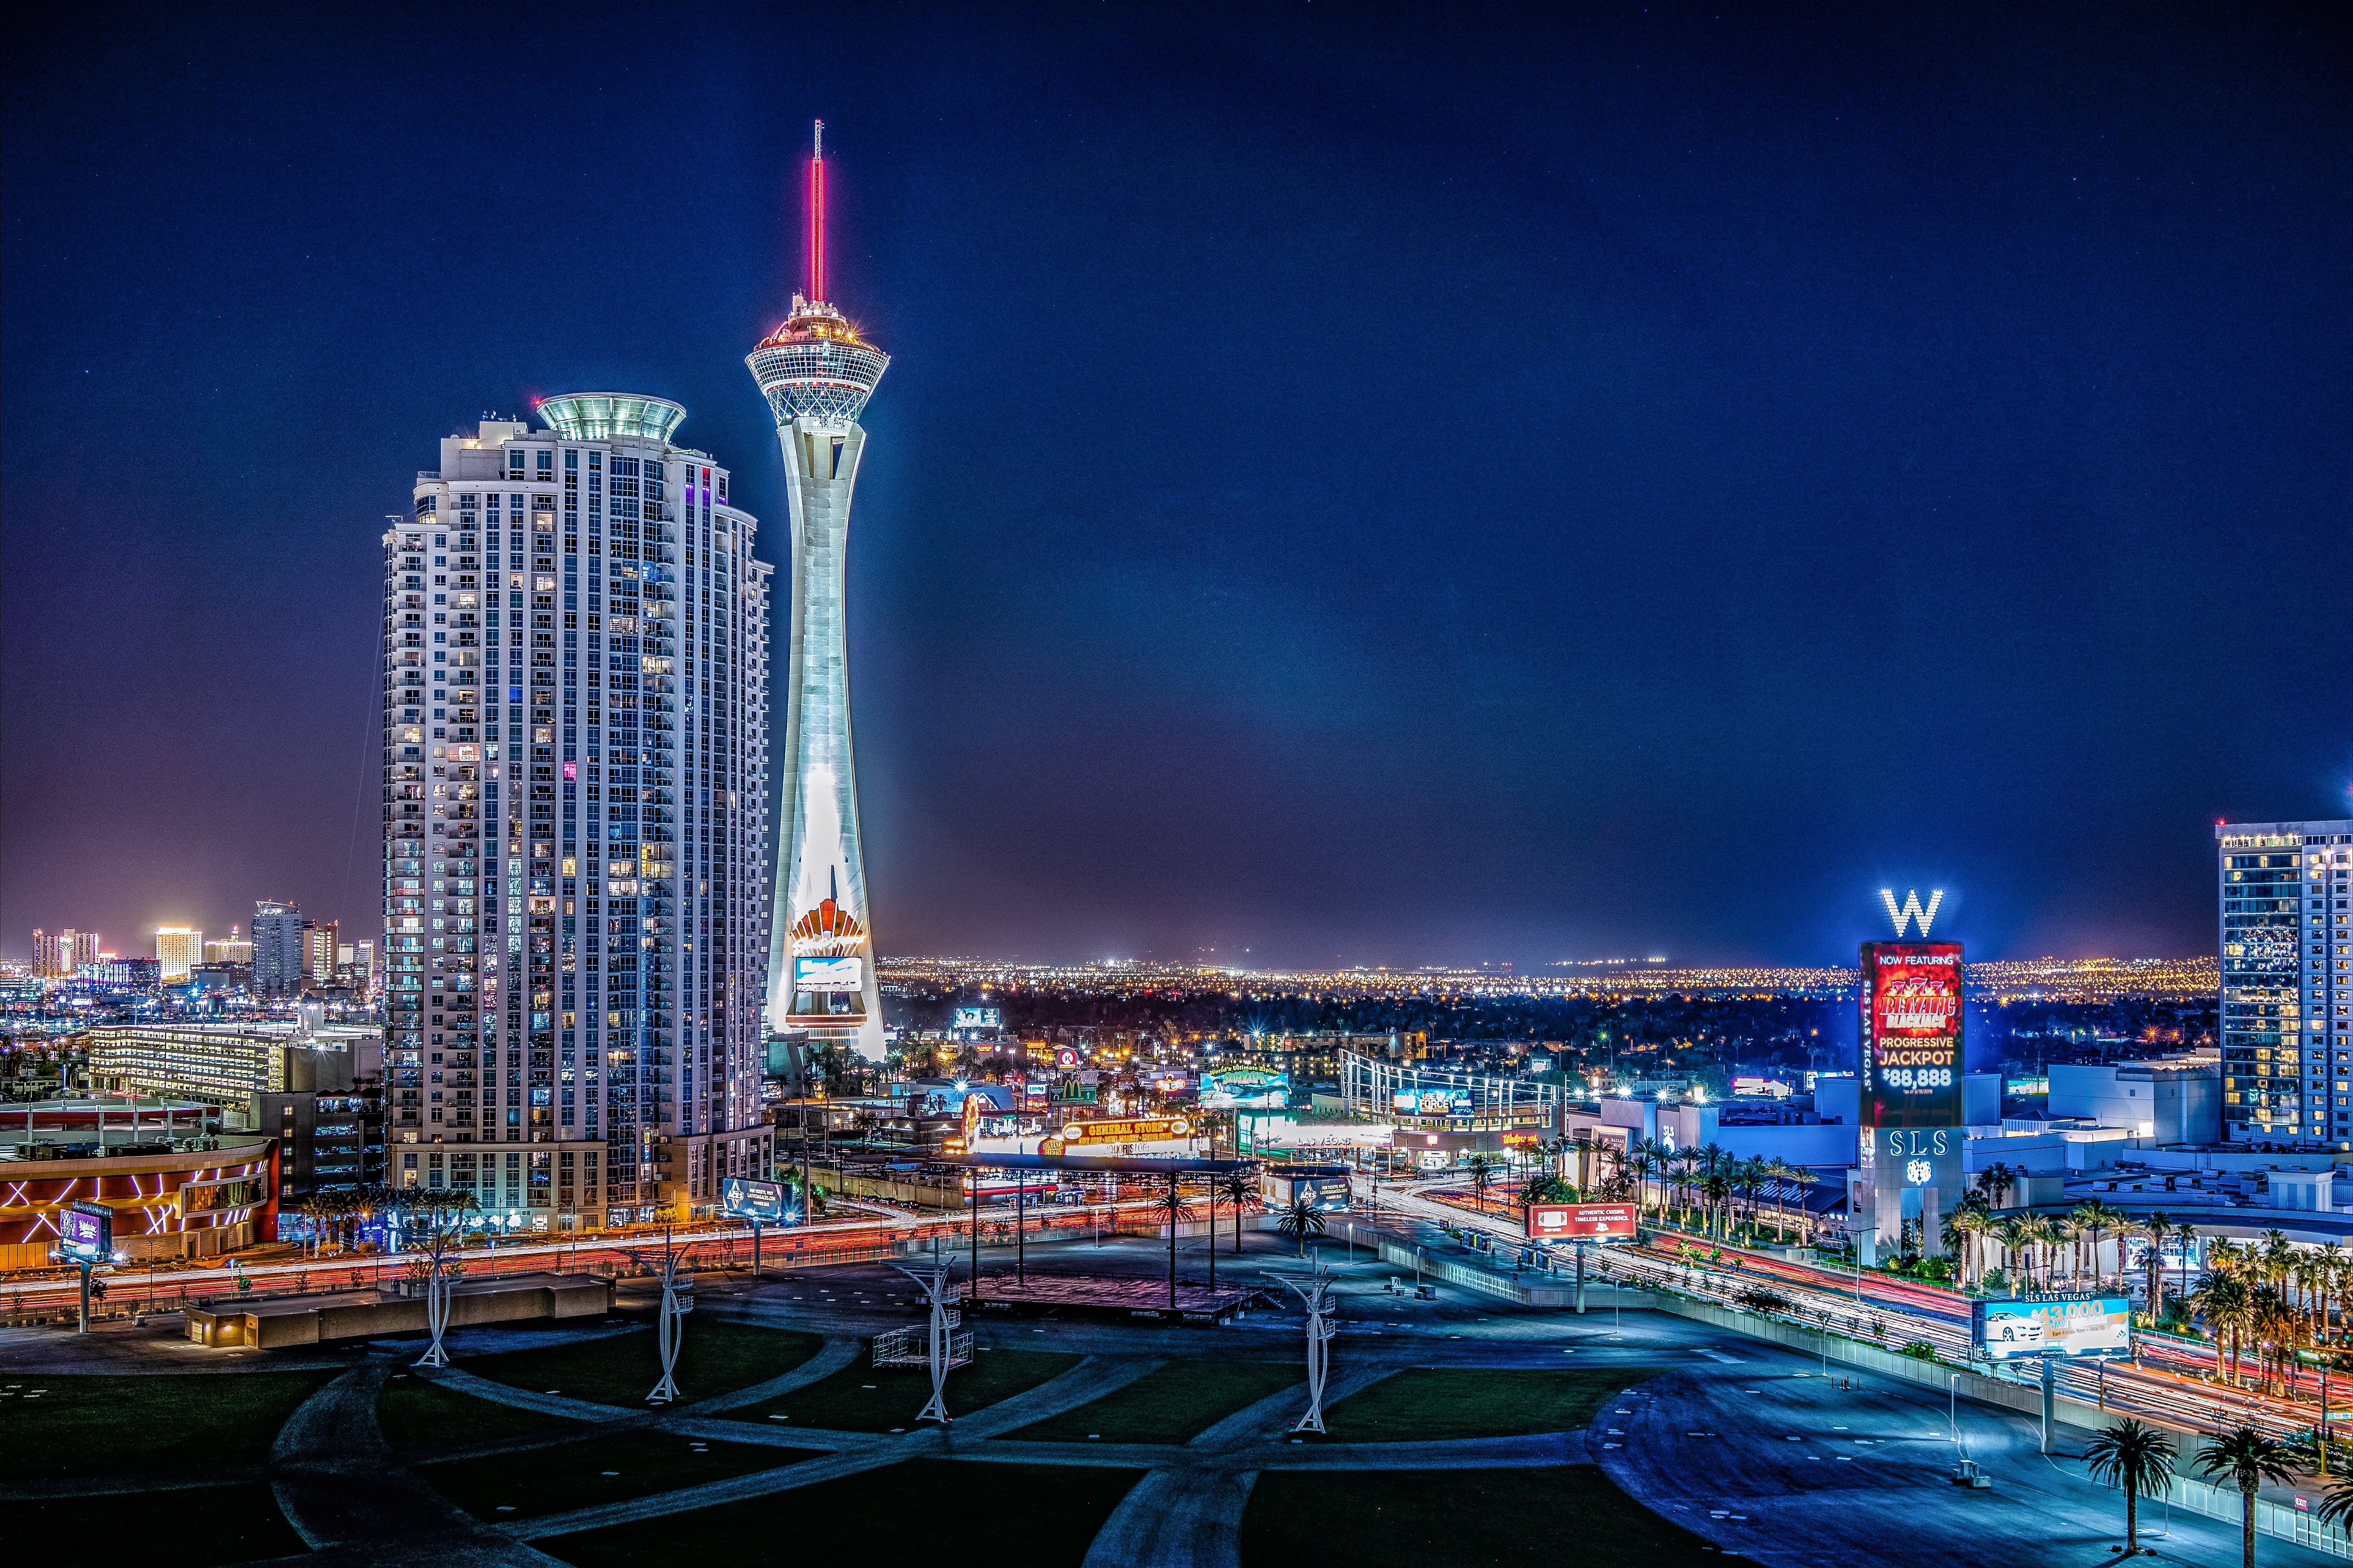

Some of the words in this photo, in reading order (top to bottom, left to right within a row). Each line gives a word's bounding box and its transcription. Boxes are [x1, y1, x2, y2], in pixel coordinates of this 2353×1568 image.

[1881, 889, 1944, 938] W
[1879, 956, 1903, 965] NOW
[1905, 956, 1953, 965] FEATURING
[1879, 996, 1956, 1016] BLAZING
[1886, 1015, 1947, 1028] BLACKJACK
[1880, 1038, 1954, 1047] PROGRESSIVE
[1879, 1051, 1954, 1066] JACKPOT
[1210, 1066, 1232, 1075] World's
[1259, 1066, 1280, 1075] Zipline
[1223, 1070, 1267, 1085] SLOTZILLA
[1882, 1068, 1951, 1089] $88,888
[1419, 1099, 1449, 1108] FORCE
[1089, 1124, 1132, 1136] GENERAL
[1134, 1122, 1164, 1133] STORE
[1663, 1125, 1675, 1137] SLS
[1043, 1141, 1063, 1150] BONANZA
[1890, 1130, 1949, 1156] SLS
[727, 1190, 744, 1201] ACES
[1299, 1191, 1317, 1200] ACES
[2025, 1294, 2040, 1302] SLS
[2043, 1293, 2059, 1302] LAS
[2296, 1497, 2307, 1508] EXIT
